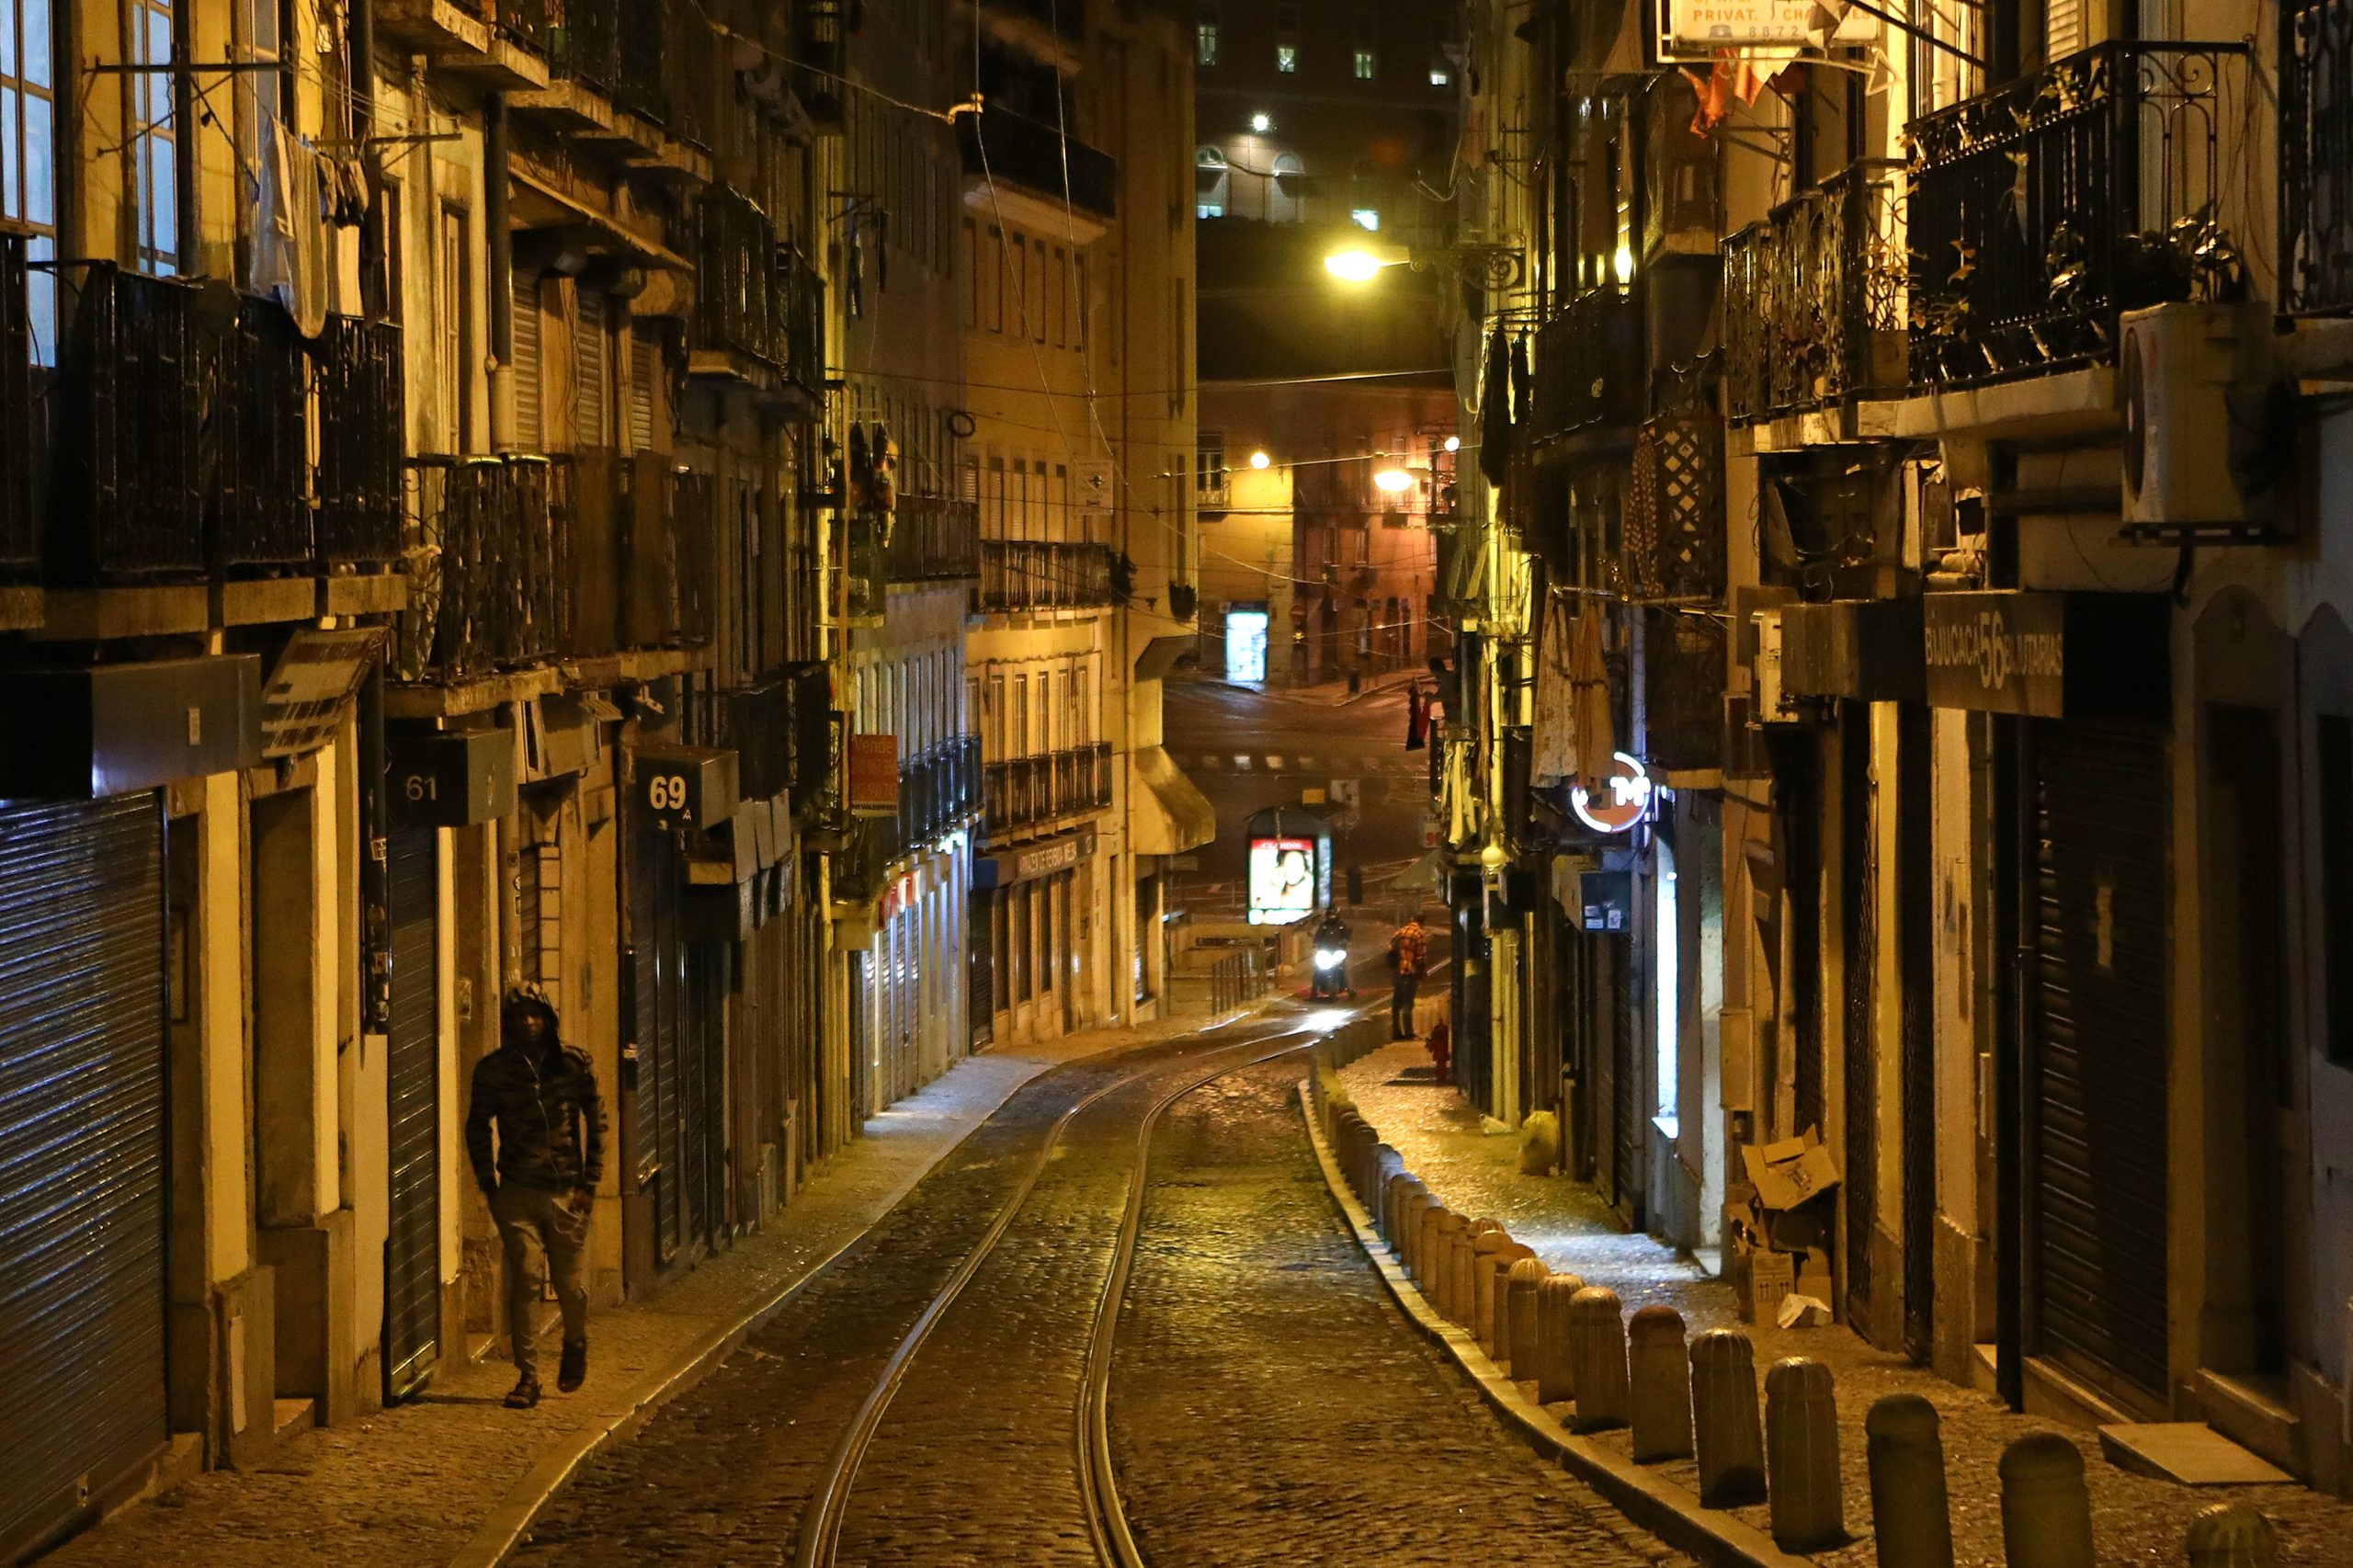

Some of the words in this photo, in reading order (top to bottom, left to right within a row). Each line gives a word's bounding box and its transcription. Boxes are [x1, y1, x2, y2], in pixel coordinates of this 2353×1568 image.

[1980, 610, 2005, 688] 56
[406, 775, 437, 801] 61
[650, 776, 687, 811] 69
